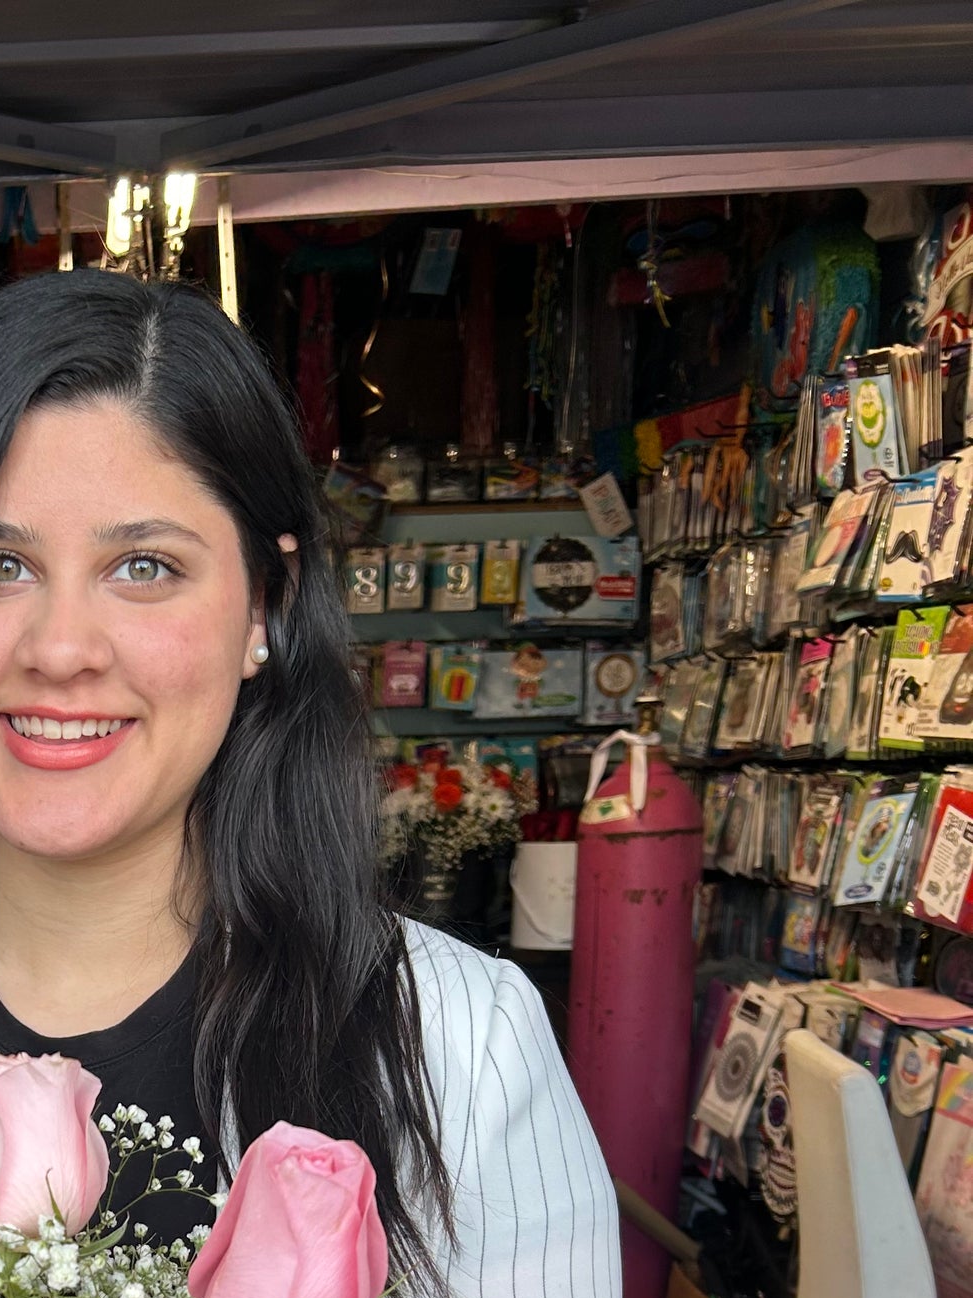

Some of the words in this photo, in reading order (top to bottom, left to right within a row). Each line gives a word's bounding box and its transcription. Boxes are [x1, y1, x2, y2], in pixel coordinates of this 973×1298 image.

[353, 566, 377, 596] 8
[394, 560, 417, 592] 9
[446, 562, 470, 593] 9
